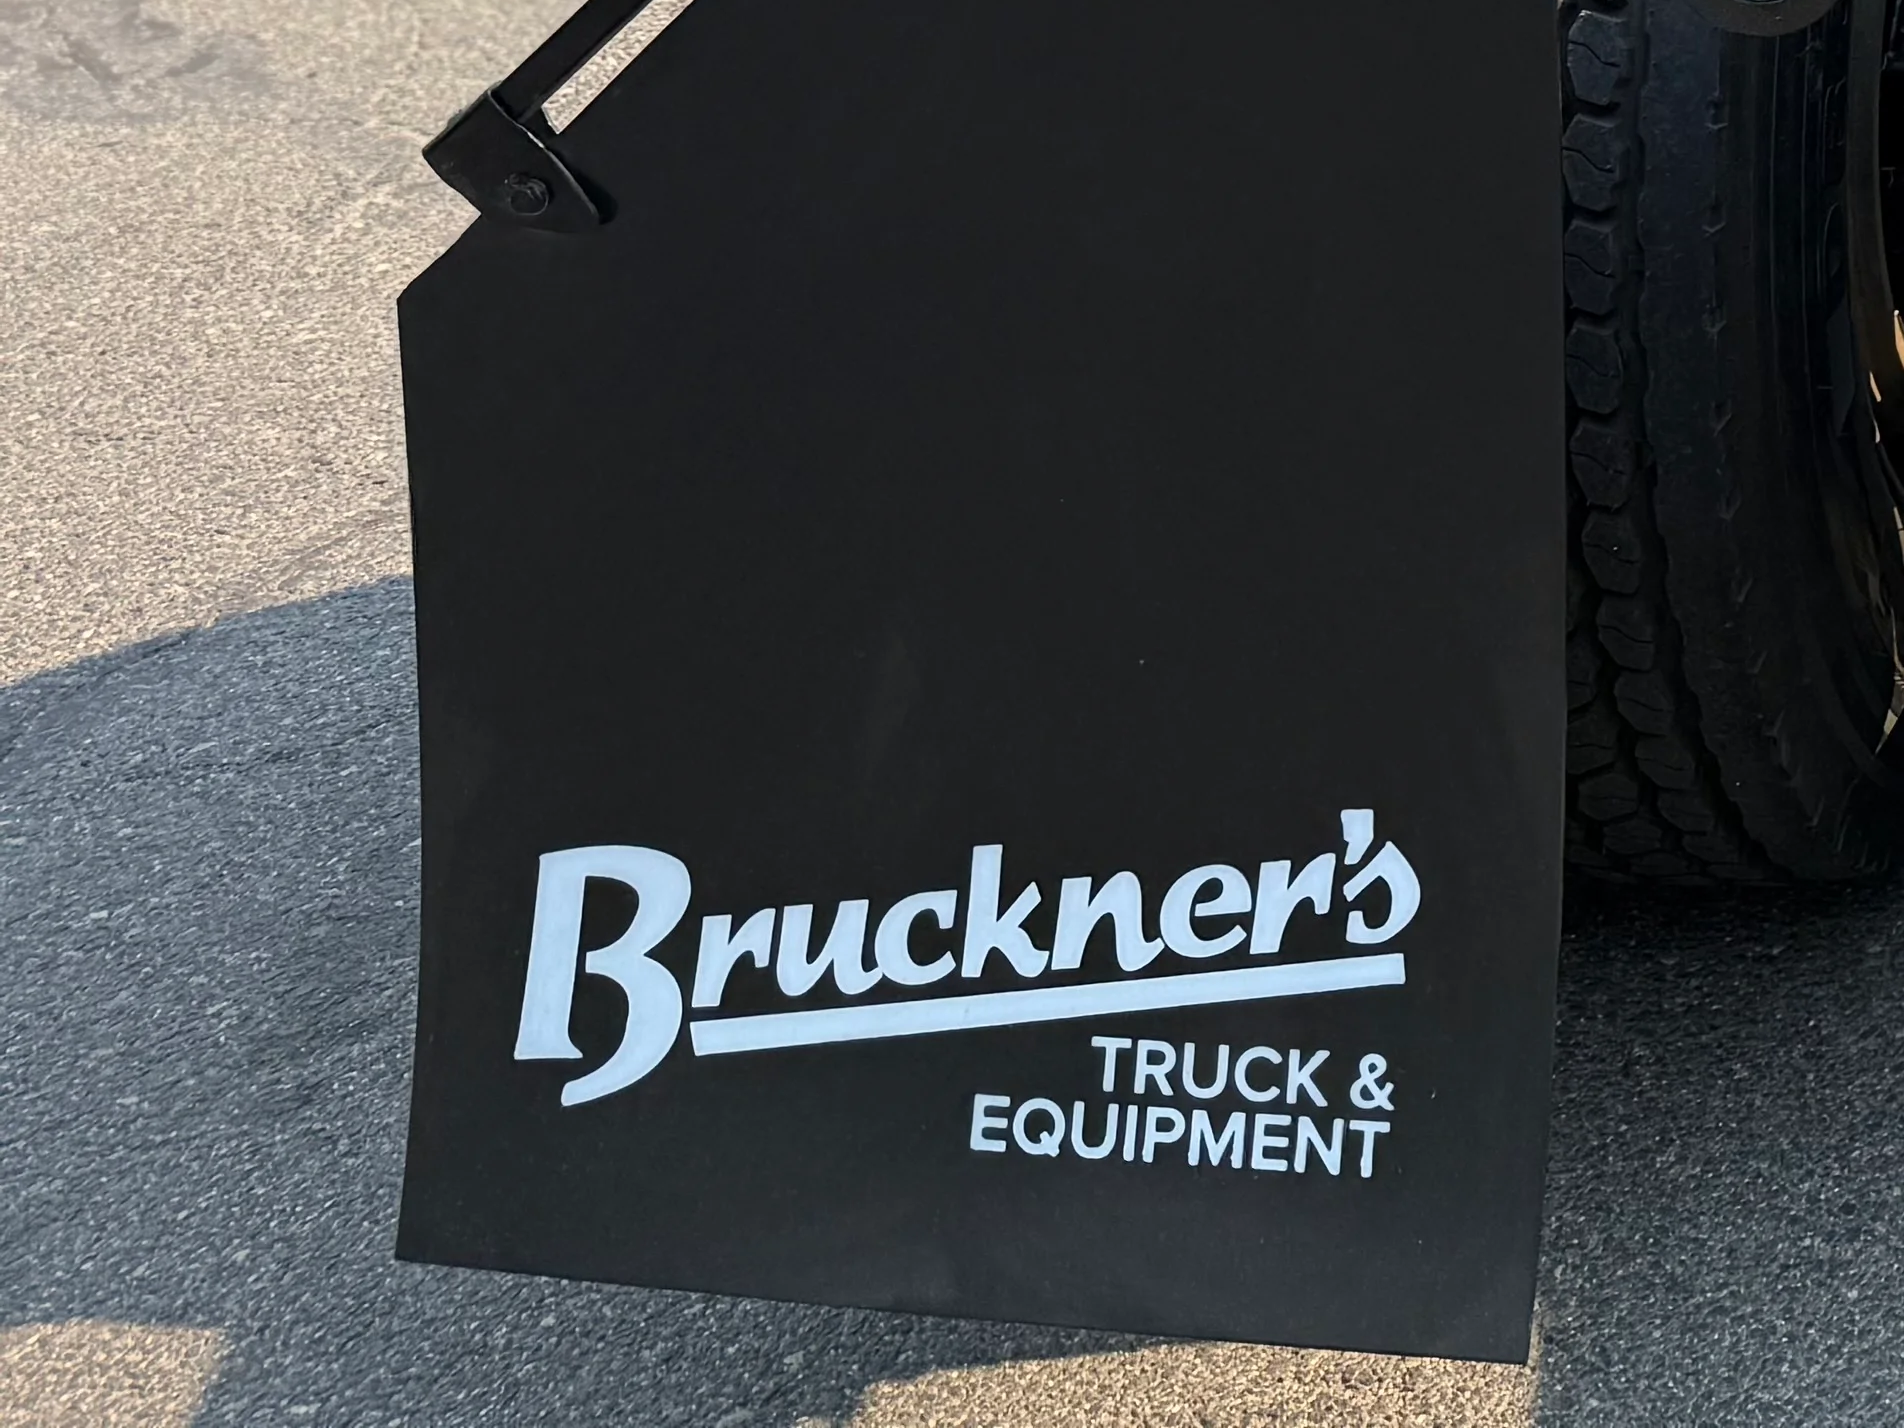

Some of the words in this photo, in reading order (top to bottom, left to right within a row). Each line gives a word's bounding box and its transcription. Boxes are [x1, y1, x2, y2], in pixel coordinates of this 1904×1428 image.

[513, 808, 1421, 1107] Bruckner's
[1090, 1035, 1331, 1108] TRUCK
[1349, 1053, 1395, 1112] &
[969, 1093, 1391, 1179] EQUIPMENT
